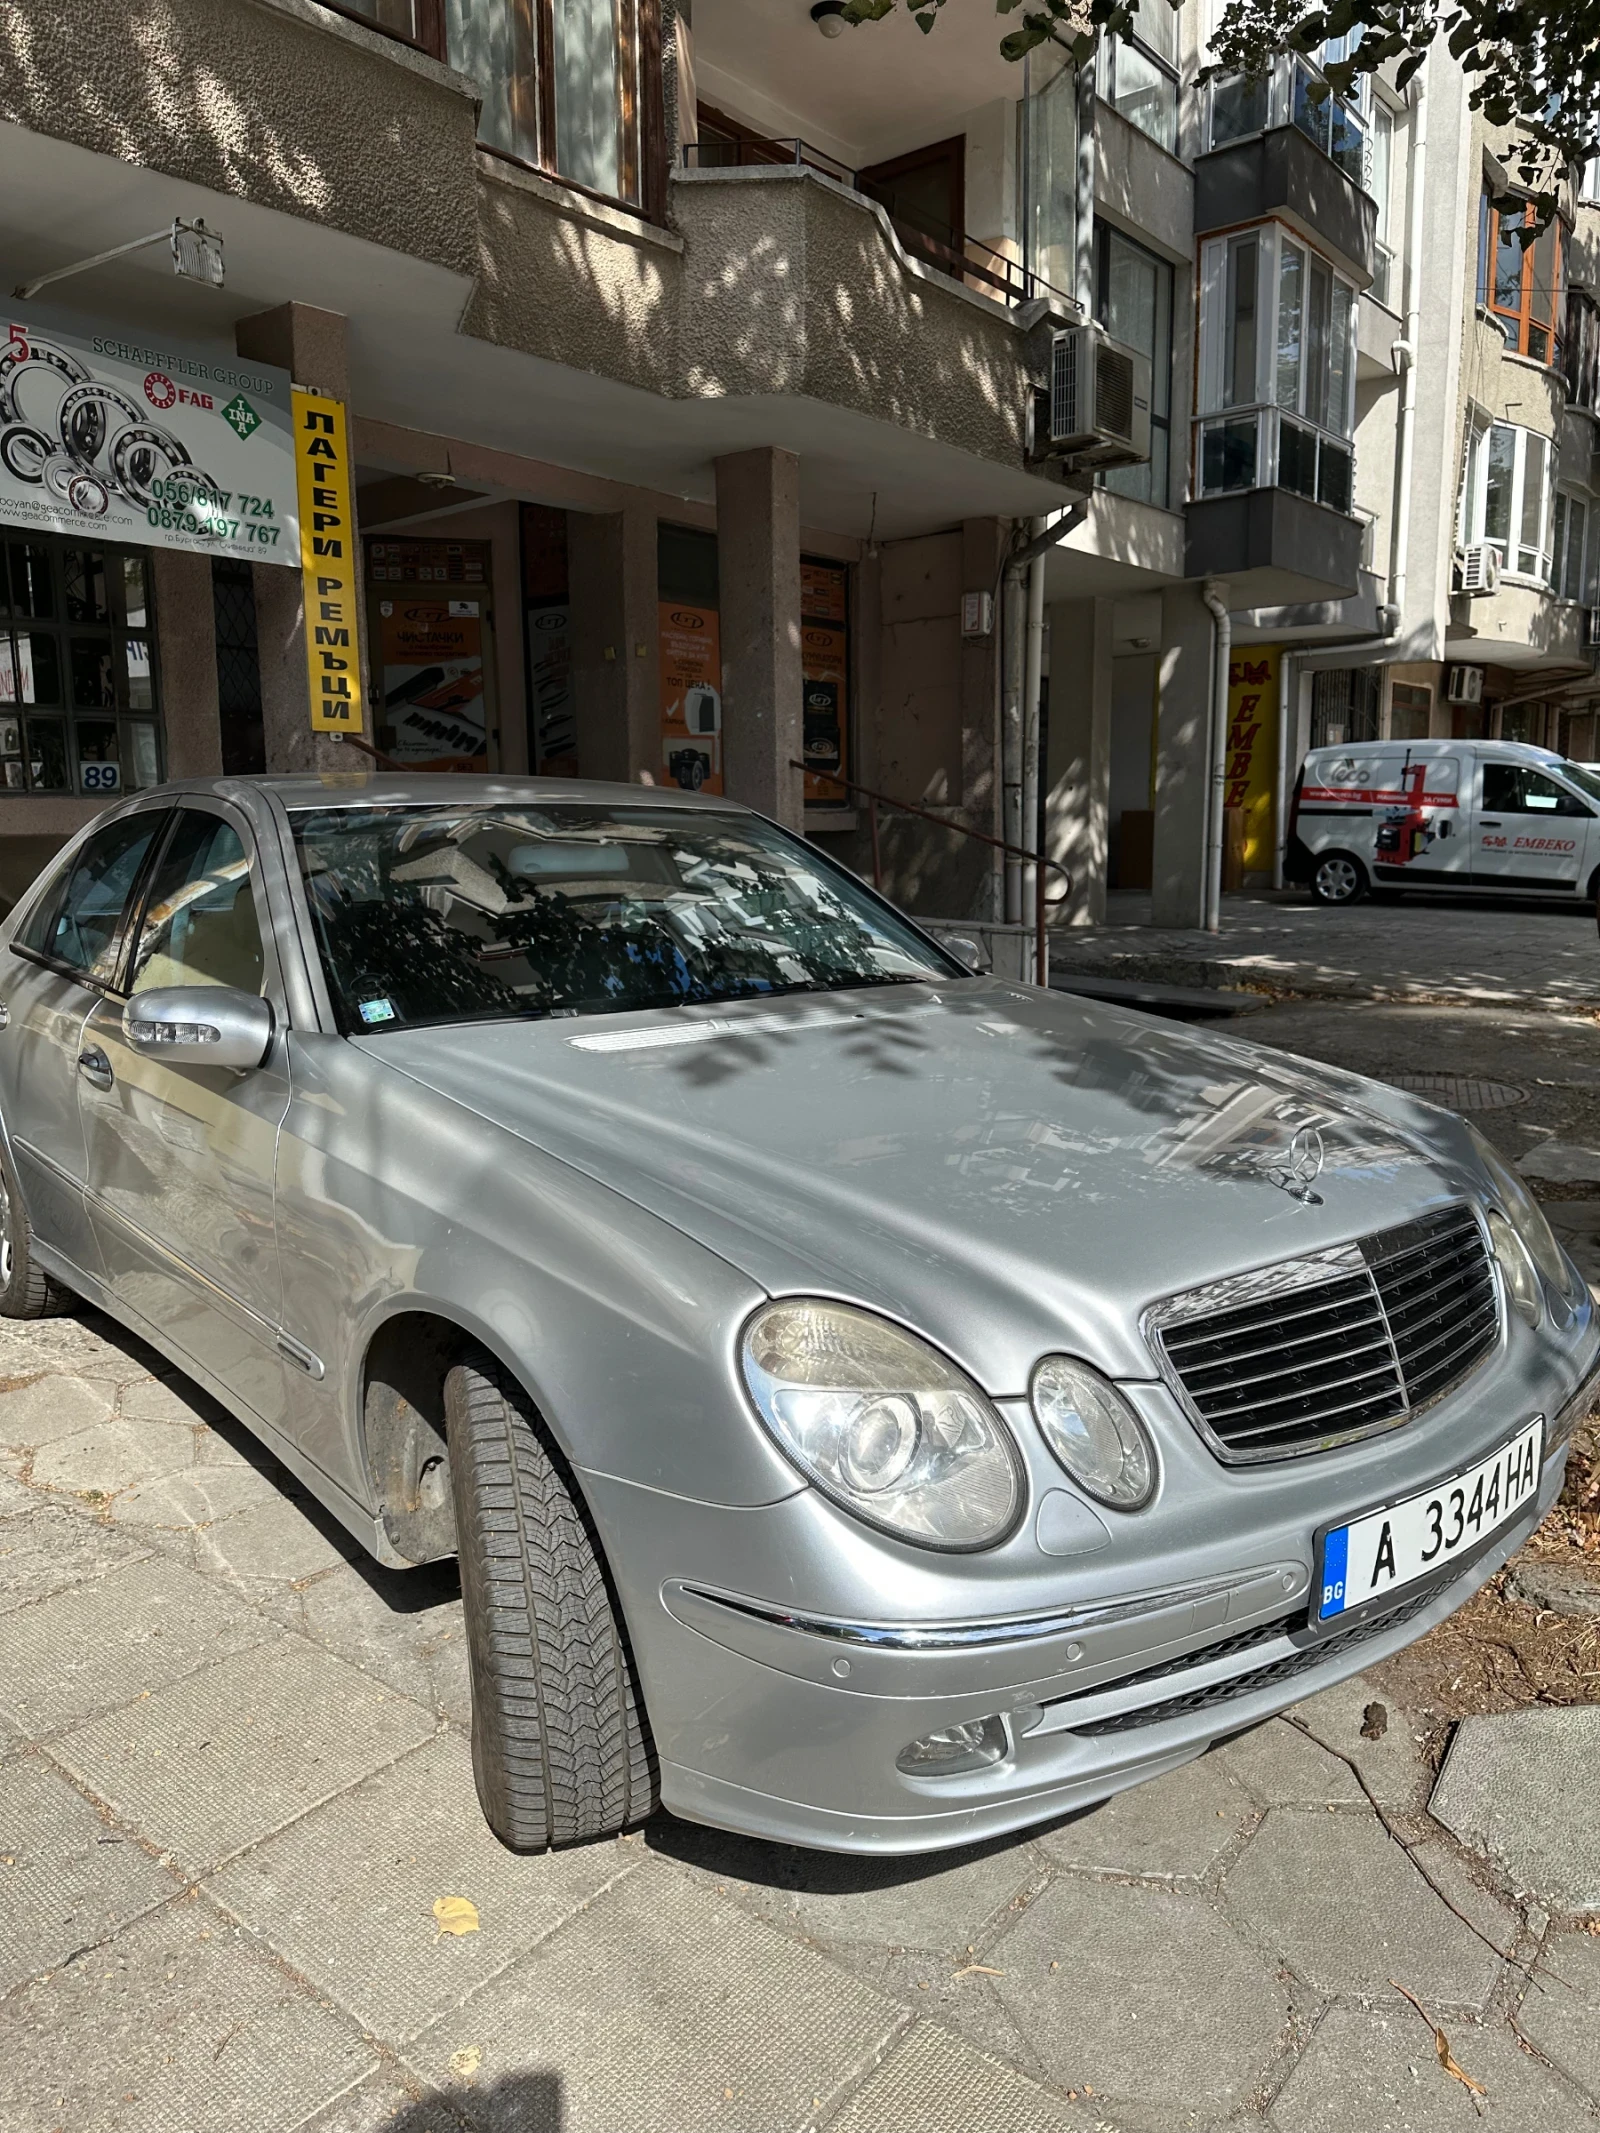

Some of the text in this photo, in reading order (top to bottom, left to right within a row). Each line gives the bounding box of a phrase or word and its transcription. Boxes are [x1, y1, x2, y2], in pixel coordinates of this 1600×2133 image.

[93, 337, 274, 394] SCHAEFFLER GROUP
[178, 388, 213, 410] FAG
[152, 479, 274, 519] 056/817 724
[0, 508, 107, 531] ww.geacommerce.com
[148, 507, 280, 546] 0879 197 767
[304, 410, 351, 720] ЛАГЕРИ РЕМЪЦИ
[396, 631, 464, 643] ЧИСТАЧКИ
[666, 677, 683, 688] ТОП
[84, 766, 117, 789] 89
[1513, 837, 1576, 851] EMBEKO
[1370, 1521, 1396, 1588] A
[1323, 1580, 1343, 1604] BG
